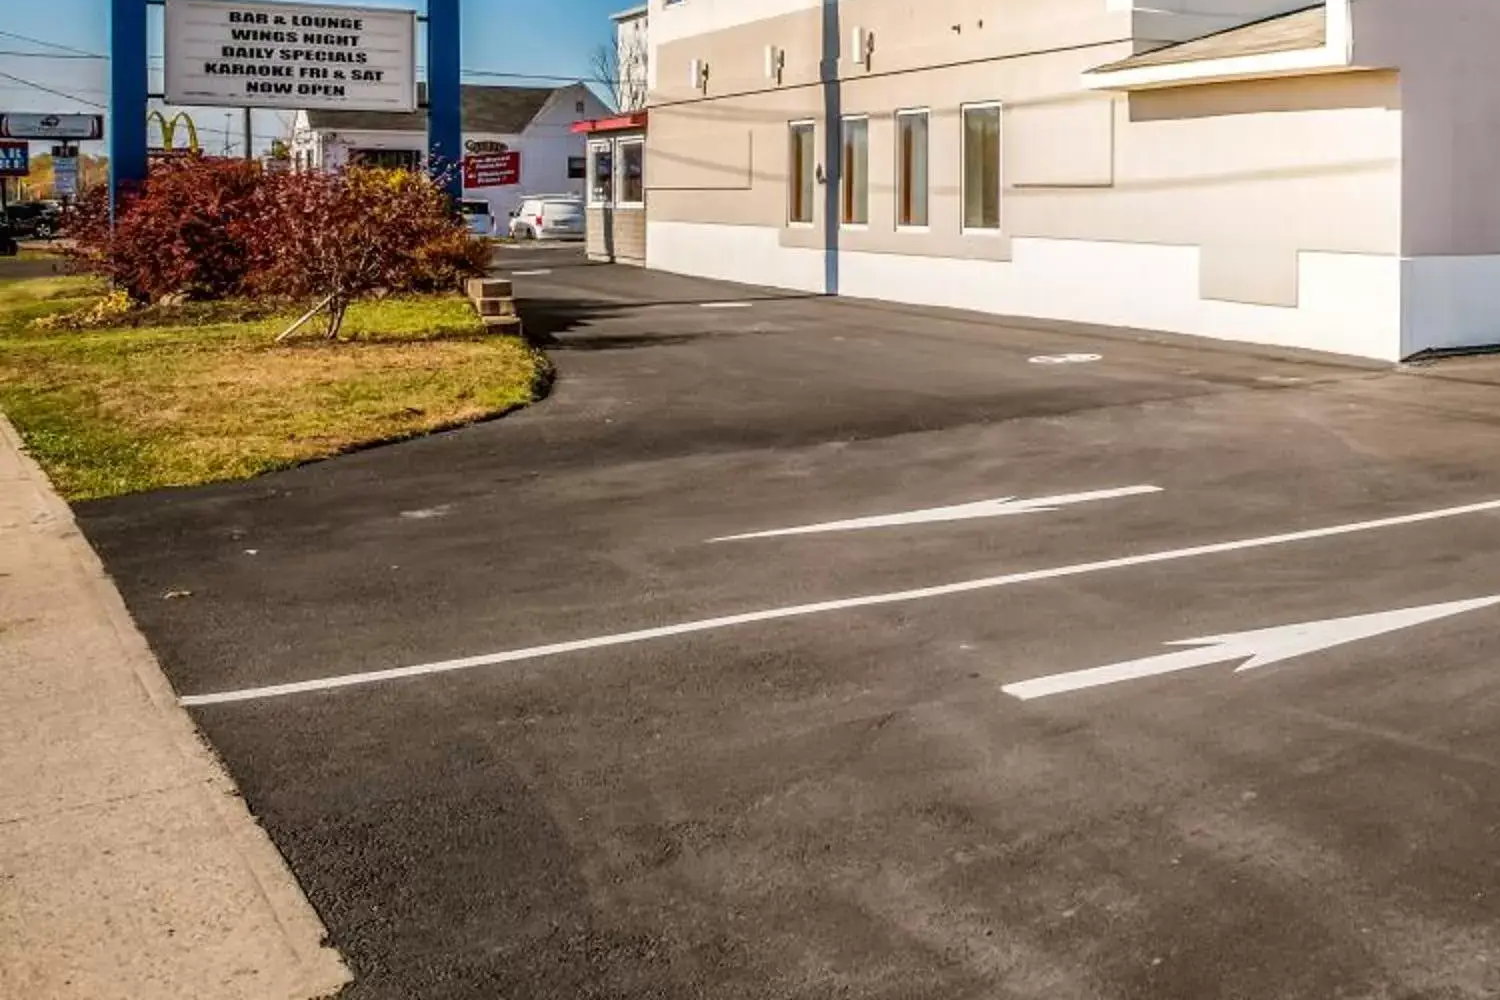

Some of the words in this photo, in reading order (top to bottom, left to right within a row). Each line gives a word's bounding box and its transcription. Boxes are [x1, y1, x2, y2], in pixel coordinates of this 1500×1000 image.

[229, 11, 269, 25] BAR
[273, 15, 286, 26] &
[292, 15, 363, 31] LOUNGE
[231, 28, 298, 43] WINGS
[302, 33, 361, 47] NIGHT
[221, 46, 275, 60] DAILY
[279, 48, 368, 64] SPECIALS
[204, 62, 294, 78] KARAOKE
[299, 66, 328, 79] FRI
[333, 70, 346, 80] &
[350, 69, 384, 82] SAT
[246, 81, 292, 96] NOW
[297, 82, 345, 97] OPEN
